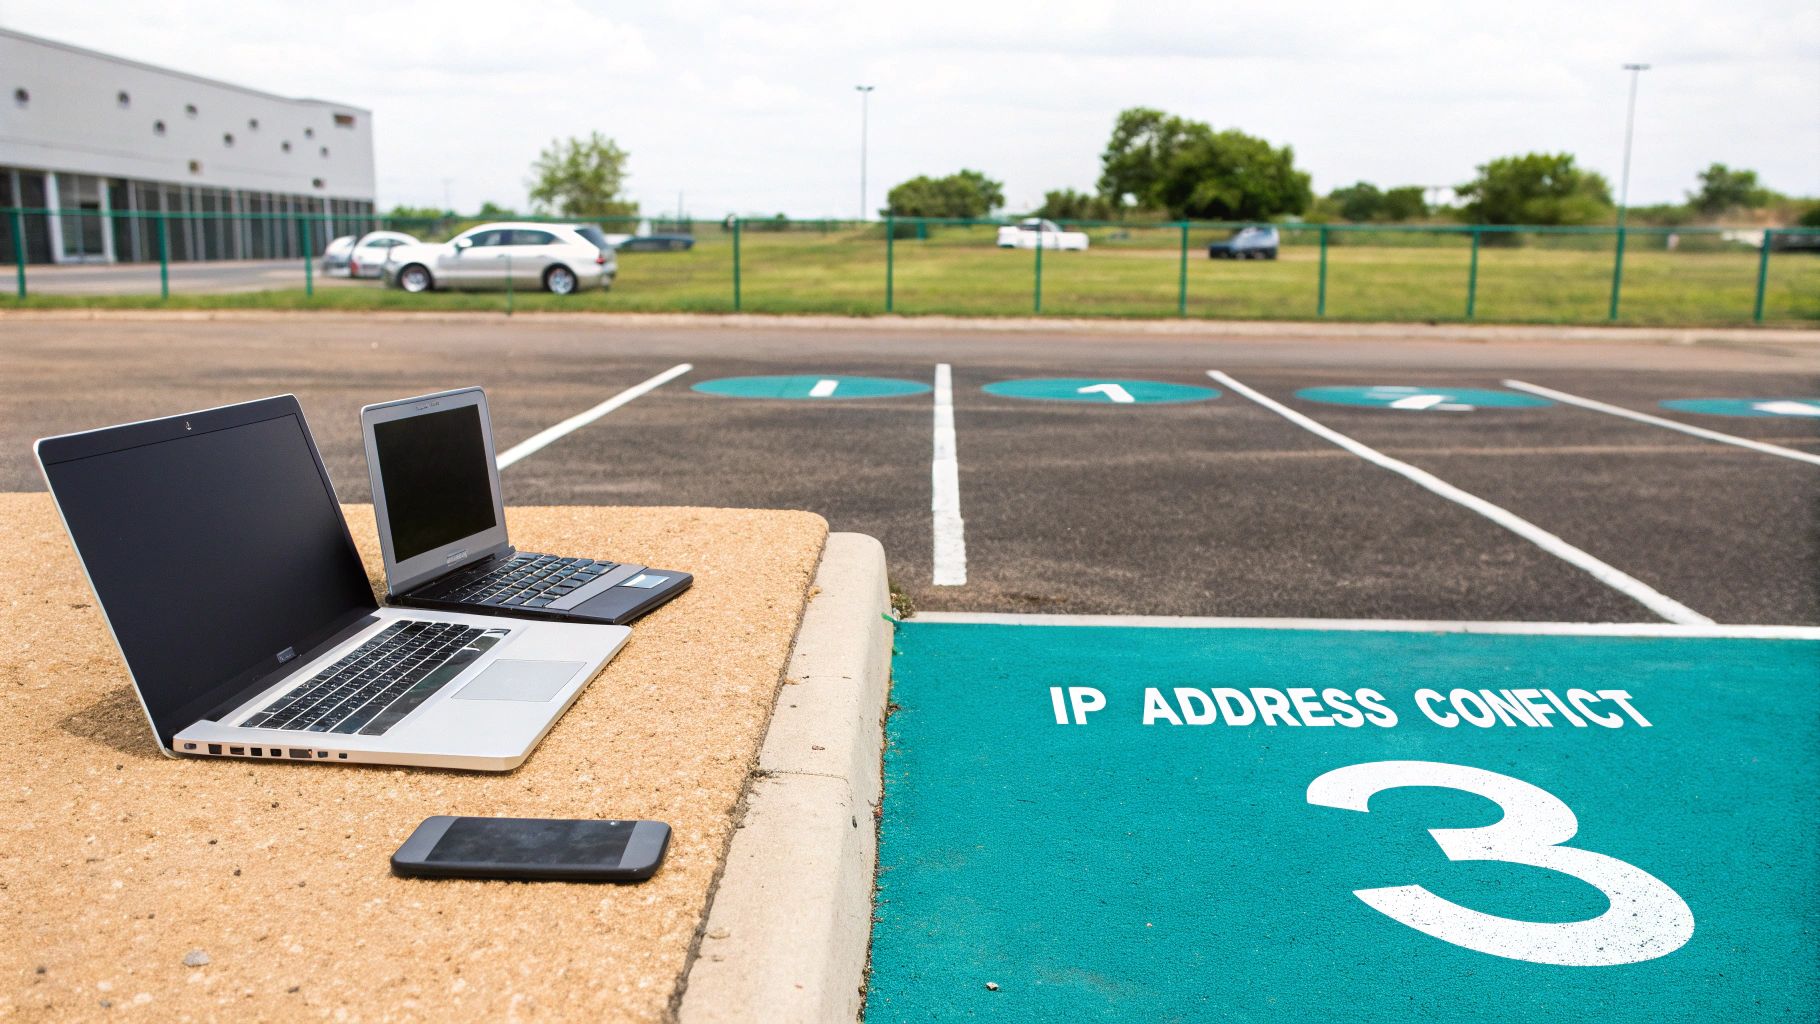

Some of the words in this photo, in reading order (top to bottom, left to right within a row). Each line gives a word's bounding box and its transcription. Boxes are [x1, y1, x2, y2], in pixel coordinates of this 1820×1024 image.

[1049, 686, 1107, 726] IP
[1142, 687, 1399, 729] ADDRESS
[1414, 688, 1653, 729] CONFICT
[1306, 760, 1695, 967] 3
